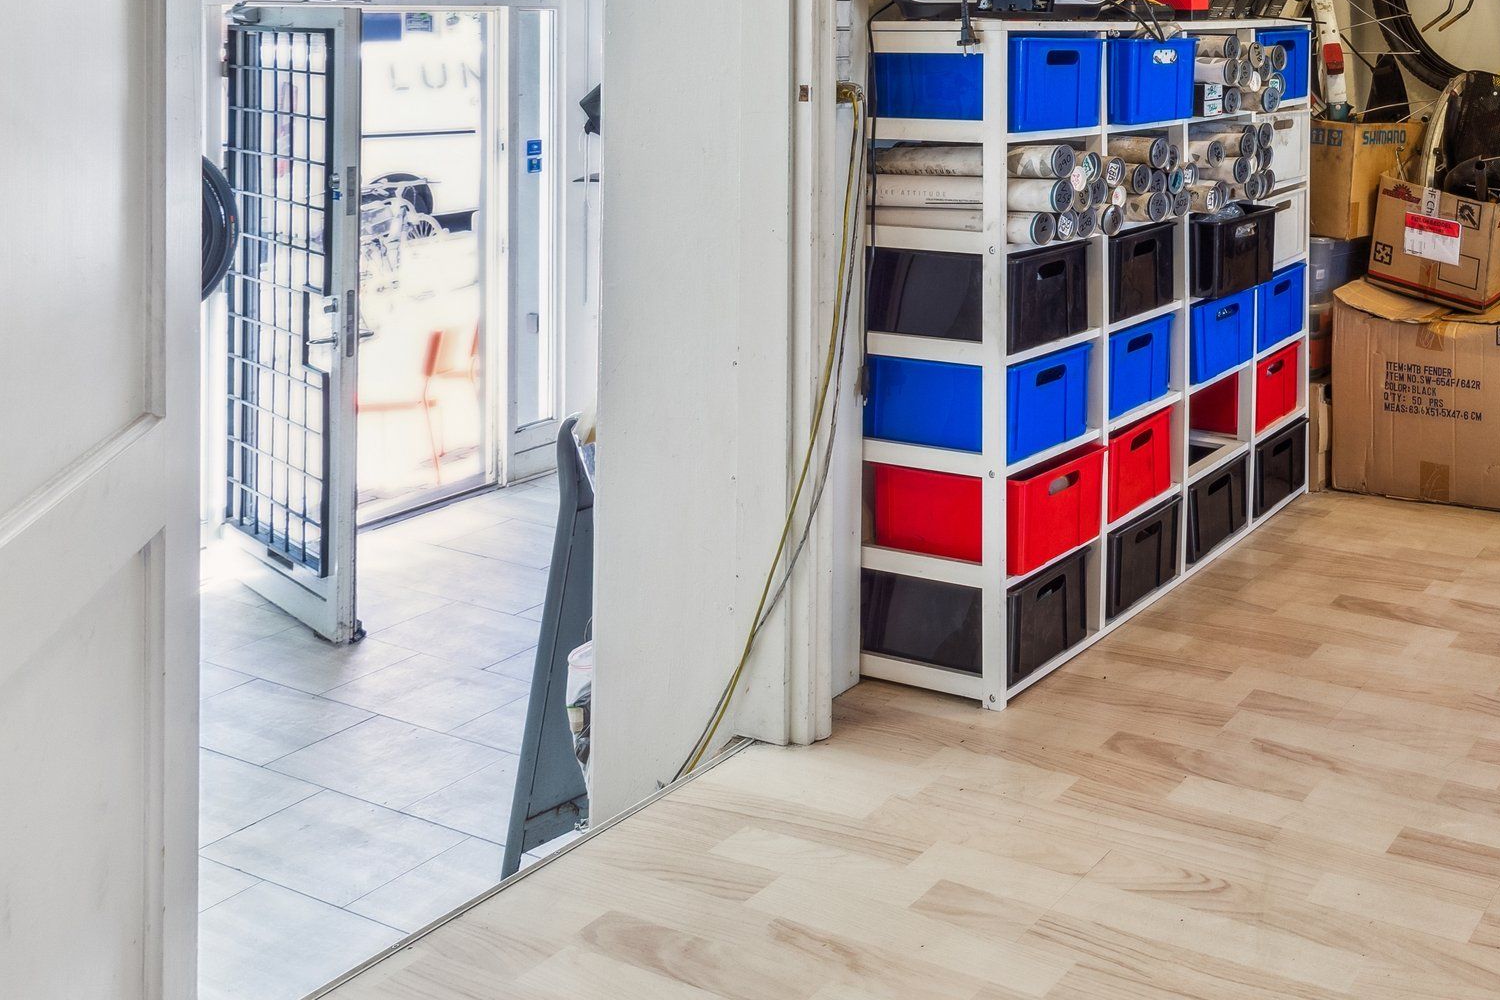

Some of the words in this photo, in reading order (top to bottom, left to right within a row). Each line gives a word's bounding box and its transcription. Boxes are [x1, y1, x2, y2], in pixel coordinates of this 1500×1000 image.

[1362, 130, 1406, 145] SHIMANO
[1386, 371, 1404, 381] ITEM
[1424, 366, 1452, 378] FENDER
[1412, 396, 1422, 406] 50
[1429, 399, 1444, 408] PRS
[1470, 412, 1482, 421] CM
